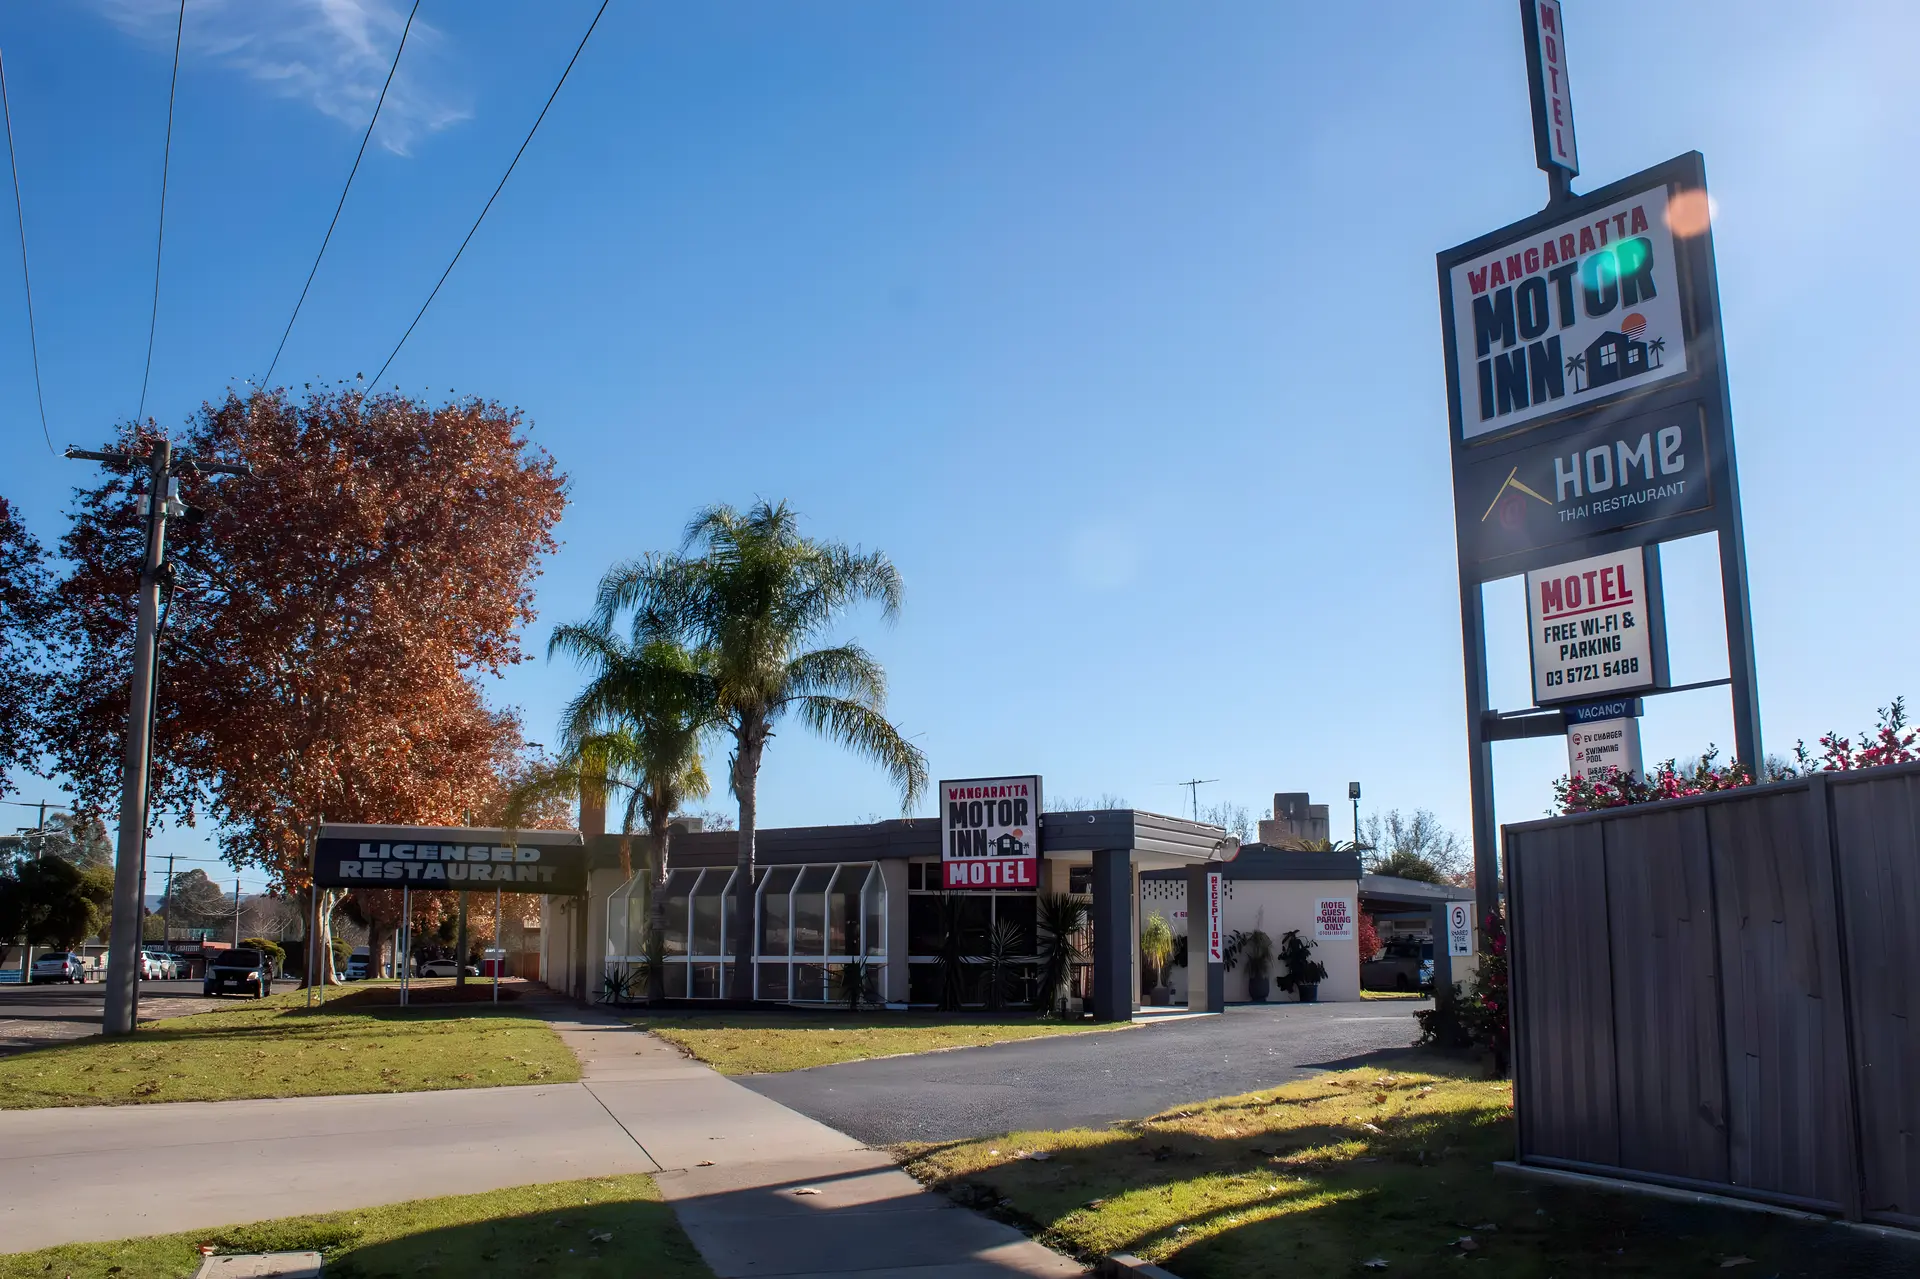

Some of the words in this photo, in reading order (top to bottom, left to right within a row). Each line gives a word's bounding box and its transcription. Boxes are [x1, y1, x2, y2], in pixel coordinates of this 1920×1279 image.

[1540, 2, 1567, 158] MOTEL
[1467, 205, 1649, 295] WANGARATTA
[1472, 237, 1657, 359] MOTOR
[1477, 334, 1565, 422] INN
[1558, 504, 1589, 523] THAI
[1593, 480, 1686, 515] RESTAURANT
[1540, 564, 1633, 614] MOTEL
[1544, 622, 1577, 643] FREE
[1581, 614, 1618, 636] WI-FI
[1622, 611, 1635, 629] &
[1560, 635, 1621, 661] PARKING
[1546, 670, 1563, 687] 03
[1566, 664, 1599, 683] 5721
[1603, 657, 1639, 678] 5488
[1578, 702, 1626, 719] VACANCY
[1583, 734, 1592, 743] EV
[1593, 730, 1622, 742] CHARGER
[1585, 743, 1619, 756] SWIMMING
[1586, 754, 1602, 763] POOL
[948, 784, 1028, 800] WANGARATTA
[949, 798, 1028, 829] MOTOR
[358, 843, 540, 862] LICENSED
[949, 829, 987, 857] INN
[339, 860, 557, 882] RESTAURANT
[949, 861, 1030, 885] MOTEL
[1211, 876, 1219, 947] RECEPTION
[1321, 901, 1346, 909] MOTEL
[1455, 911, 1462, 925] 5
[1324, 923, 1344, 931] ONLY
